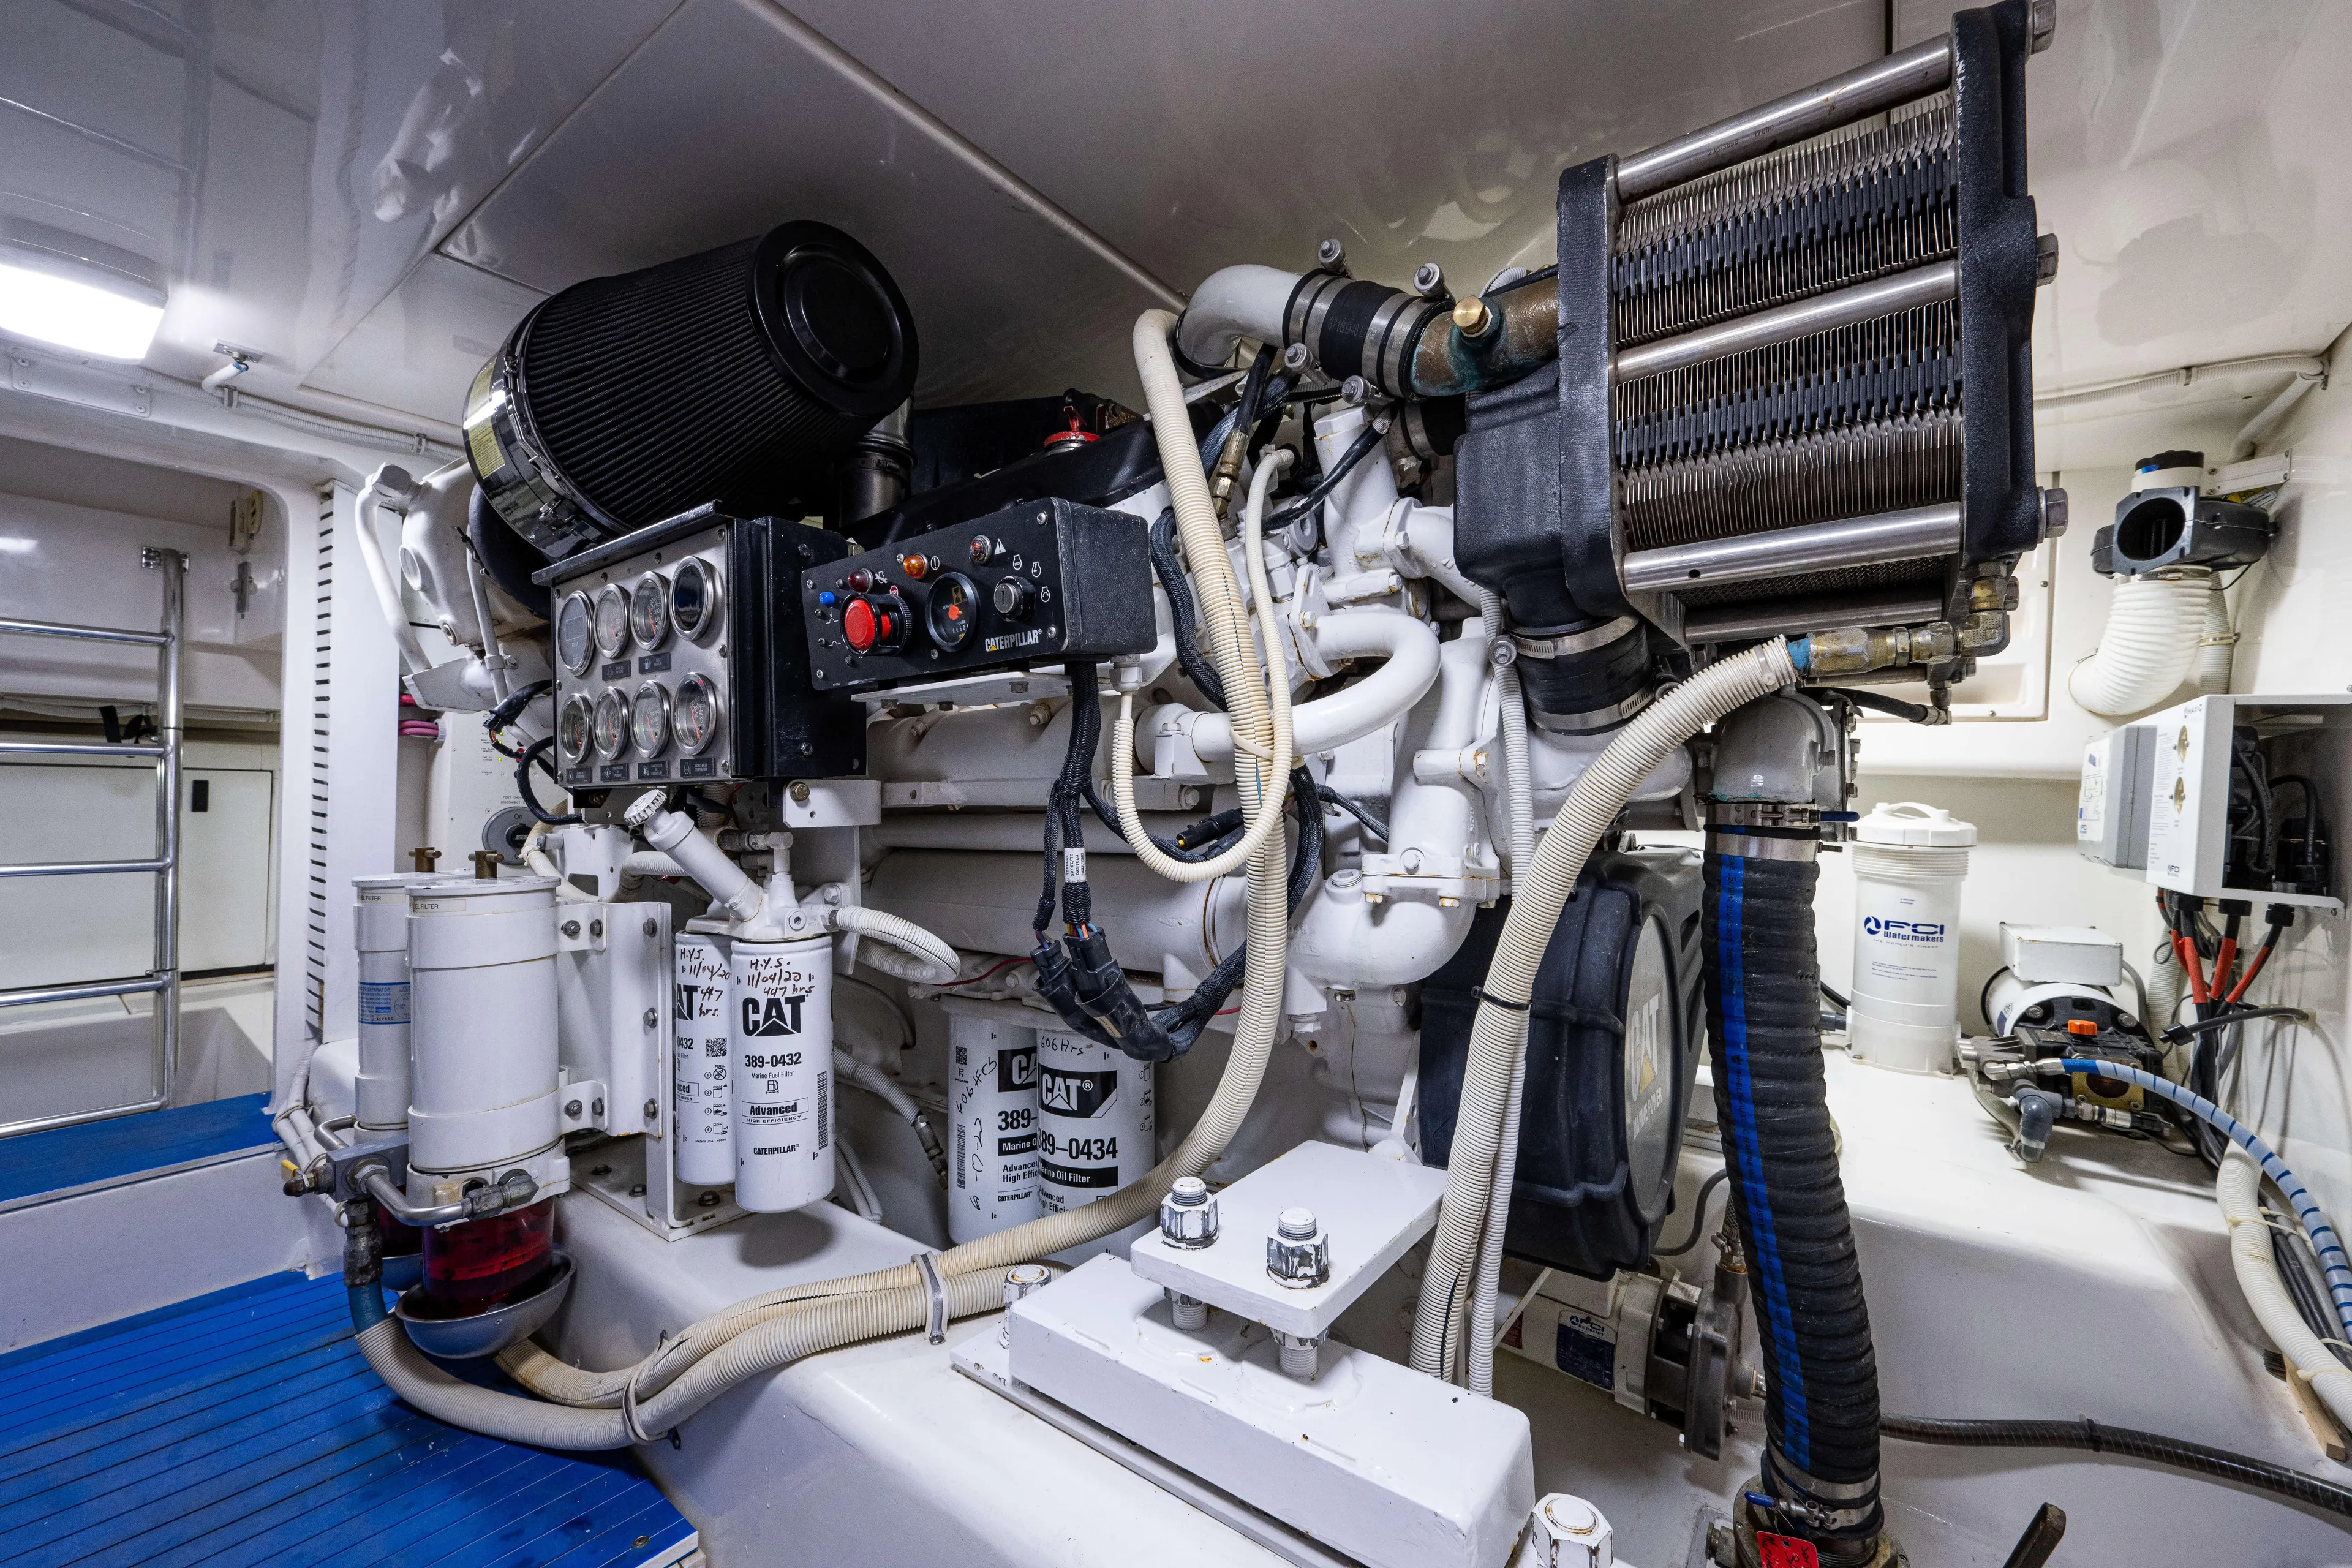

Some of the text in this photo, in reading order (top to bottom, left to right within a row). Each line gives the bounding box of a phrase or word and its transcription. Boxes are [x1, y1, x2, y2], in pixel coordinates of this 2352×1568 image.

[1884, 920, 1945, 935] FCI
[1883, 931, 1944, 943] Watermakers
[676, 983, 698, 1021] AT
[1630, 993, 1660, 1101] CAT
[745, 1052, 802, 1068] 389-0432
[750, 1102, 797, 1115] Advanced
[1632, 1086, 1662, 1140] MARINE POWER
[763, 1115, 801, 1123] EFFICIENCY
[1003, 1140, 1030, 1152] Marine
[1003, 1174, 1021, 1183] High
[1039, 1161, 1090, 1183] Marine Oil Filter
[1039, 1185, 1065, 1204] Advanced
[1039, 1196, 1048, 1210] High
